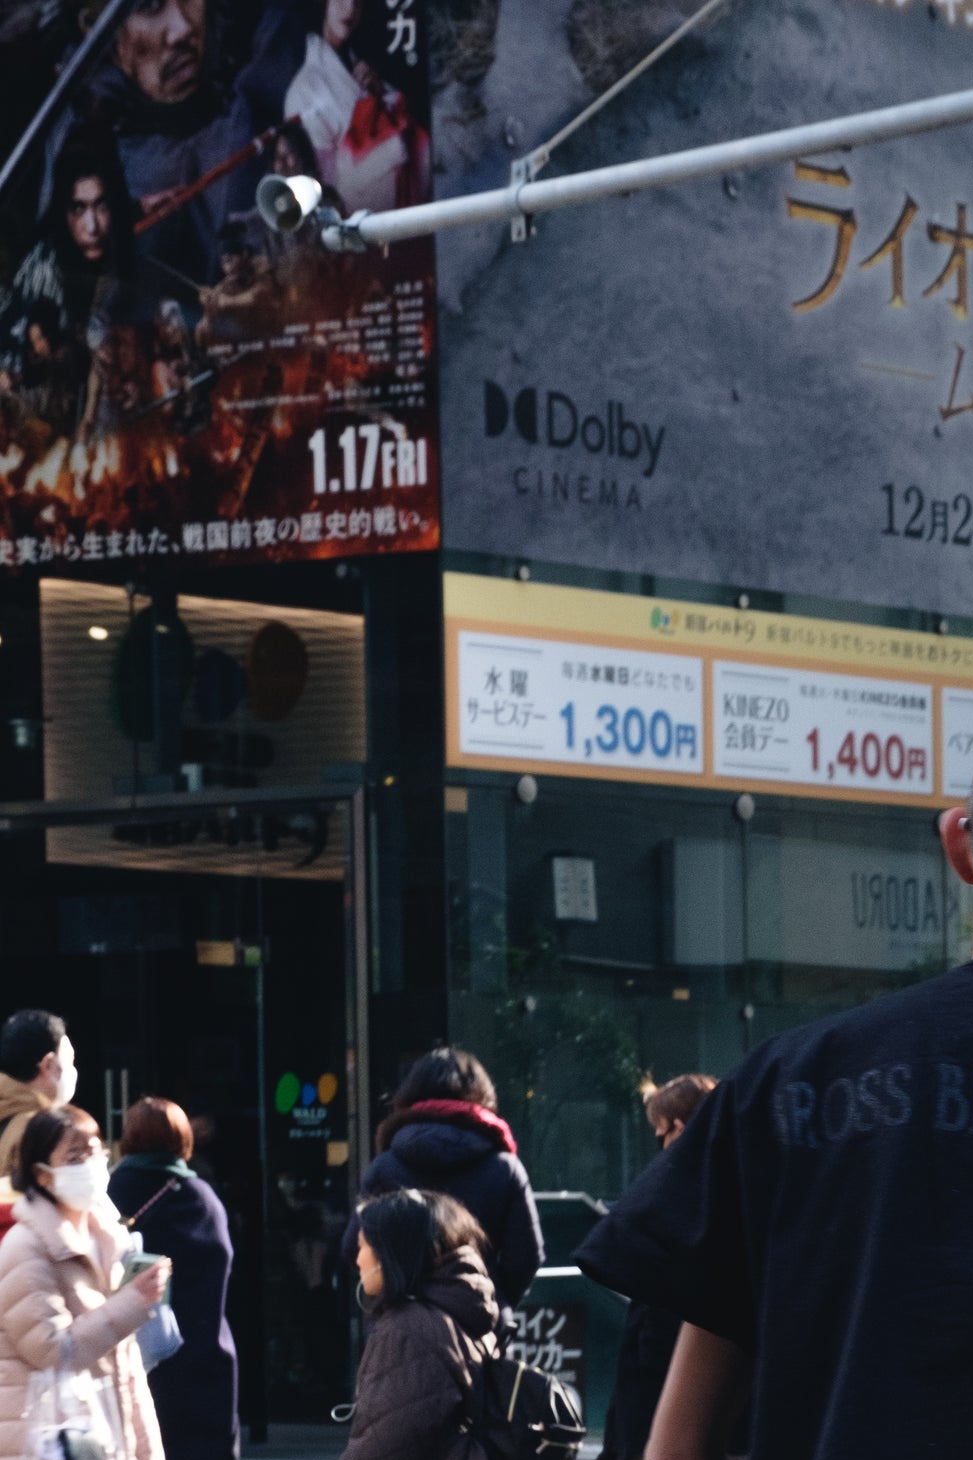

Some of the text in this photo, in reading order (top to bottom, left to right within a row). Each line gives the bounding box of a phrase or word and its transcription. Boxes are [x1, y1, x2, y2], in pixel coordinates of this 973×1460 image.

[547, 390, 665, 478] Dolby
[514, 467, 641, 511] CINEMA
[484, 666, 529, 698] 水曜
[467, 697, 546, 727] サービスデー
[723, 693, 790, 722] KINEZO
[560, 701, 697, 759] 1,300円
[724, 722, 788, 751] 会員デー
[806, 726, 927, 781] 1,400円
